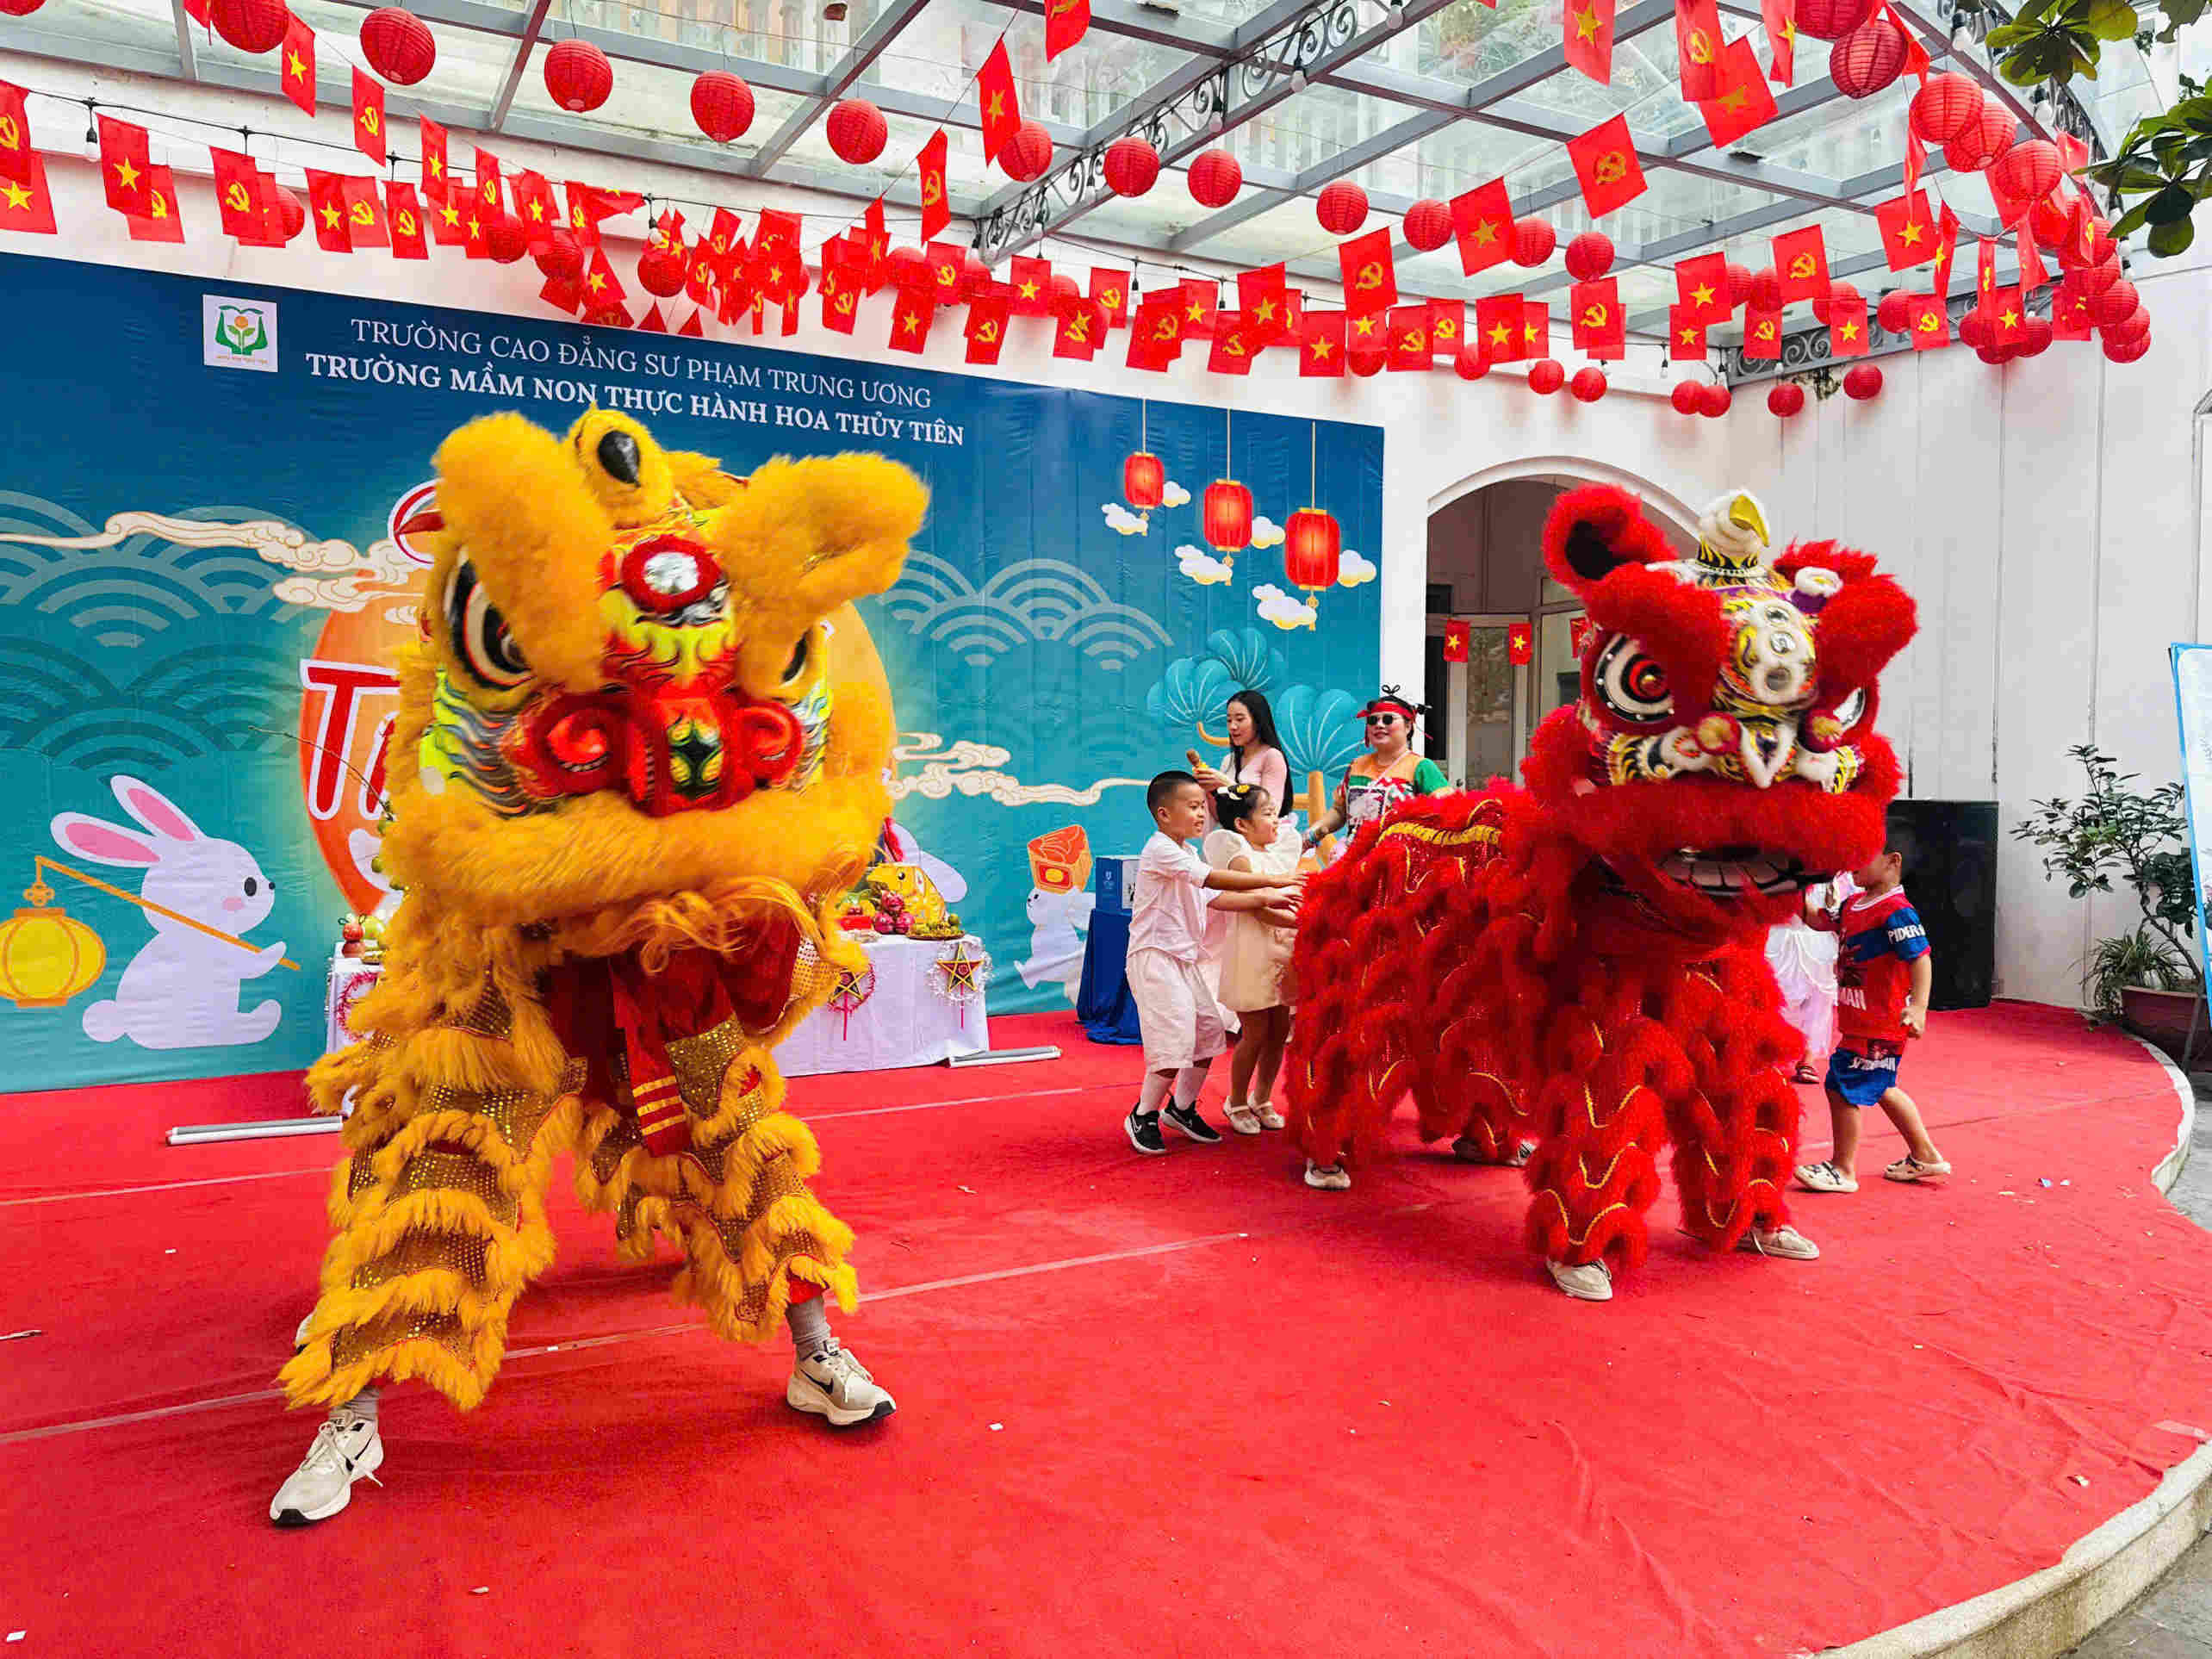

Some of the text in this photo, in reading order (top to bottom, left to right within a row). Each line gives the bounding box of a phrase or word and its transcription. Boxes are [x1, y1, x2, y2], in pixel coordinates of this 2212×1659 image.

[305, 353, 965, 445] TRƯỜNG MẦM NON THỰC HÀNH HOA THỦY TIÊN
[351, 320, 931, 409] TRƯỜNG CAO ĐẲNG SƯ PHẠM TRUNG ƯƠNG
